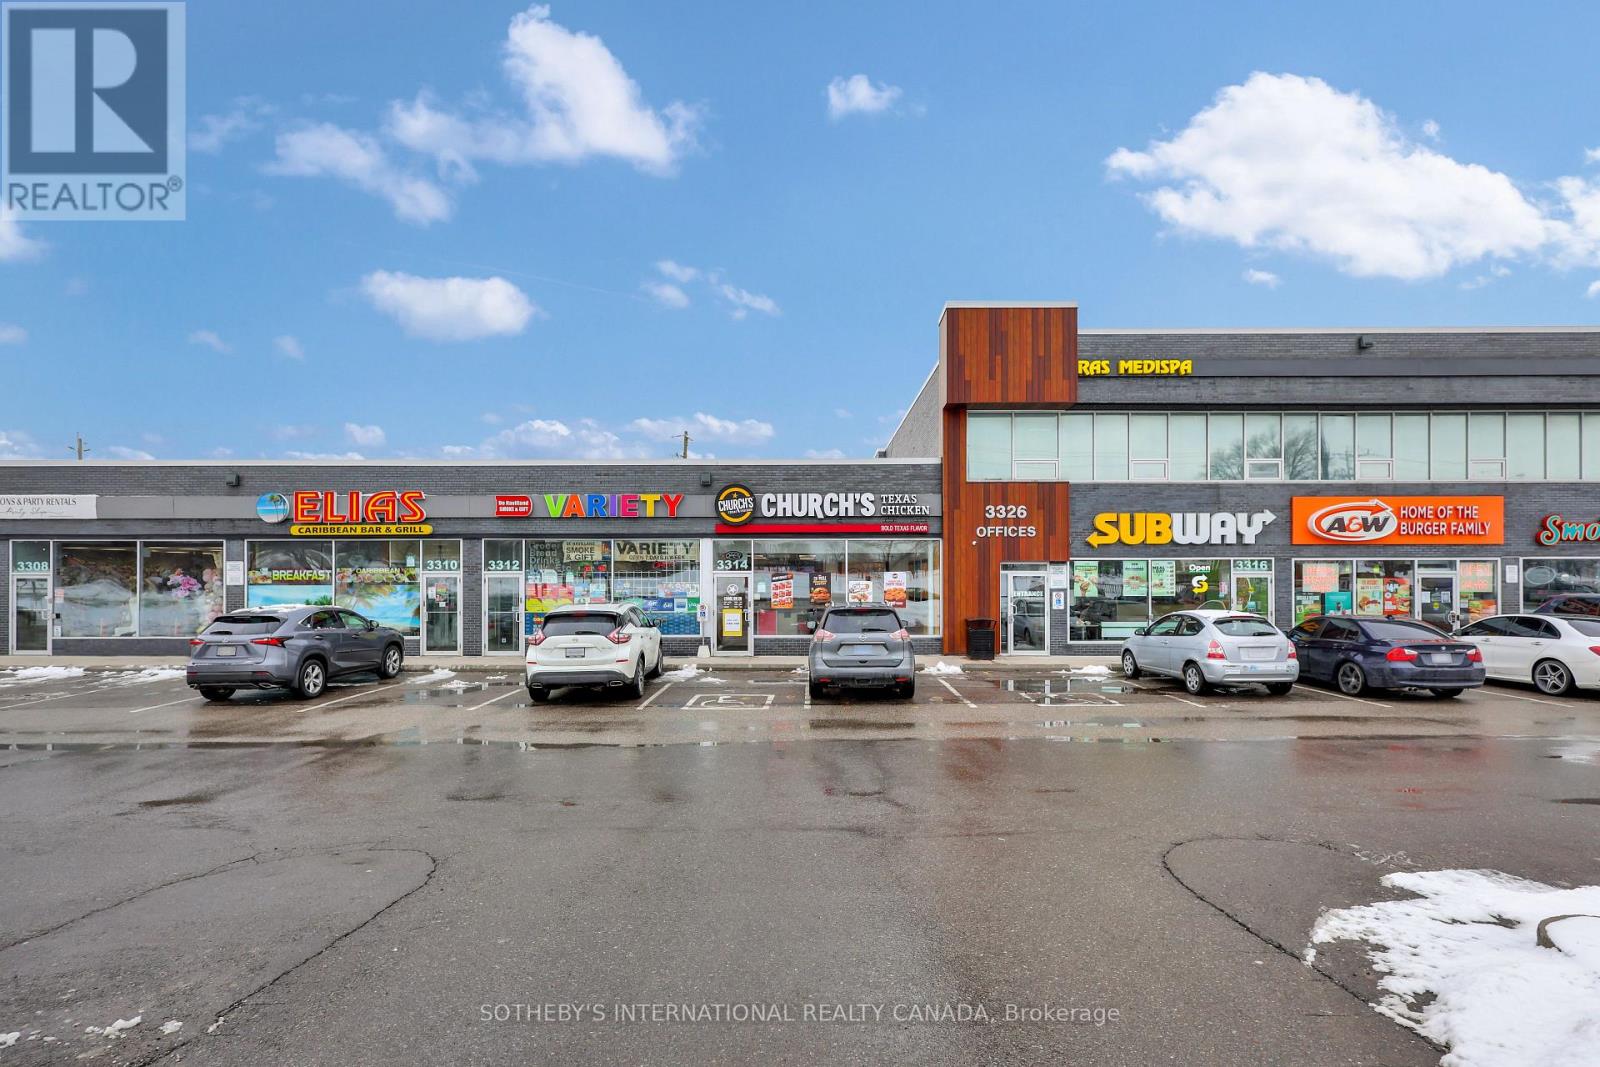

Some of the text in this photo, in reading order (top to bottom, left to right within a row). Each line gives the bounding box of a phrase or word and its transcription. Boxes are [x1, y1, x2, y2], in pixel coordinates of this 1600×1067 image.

[1078, 359, 1192, 376] RAS MEDISPA
[23, 497, 44, 506] PARTY
[46, 497, 77, 506] RENTALS
[718, 497, 754, 513] CHURCH'S
[881, 494, 917, 504] TEXAS
[293, 490, 426, 523] ELIAS
[544, 494, 684, 518] VARIETY
[761, 492, 875, 519] CHURCH'S
[881, 505, 930, 515] CHICKEN
[985, 505, 1027, 519] 3326
[1400, 505, 1479, 519] HOME OF THE
[1086, 510, 1277, 548] SUBWAY
[1326, 516, 1390, 533] A&W
[1400, 521, 1492, 535] BURGER FAMILY
[976, 526, 1037, 537] OFFICES
[616, 542, 694, 555] VARIETY
[17, 561, 49, 571] 3308
[426, 560, 458, 570] 3310
[488, 560, 520, 570] 3312
[717, 560, 749, 570] 3314
[1189, 564, 1211, 575] Open
[1236, 561, 1268, 570] 3316
[272, 570, 331, 581] BREAKFAST
